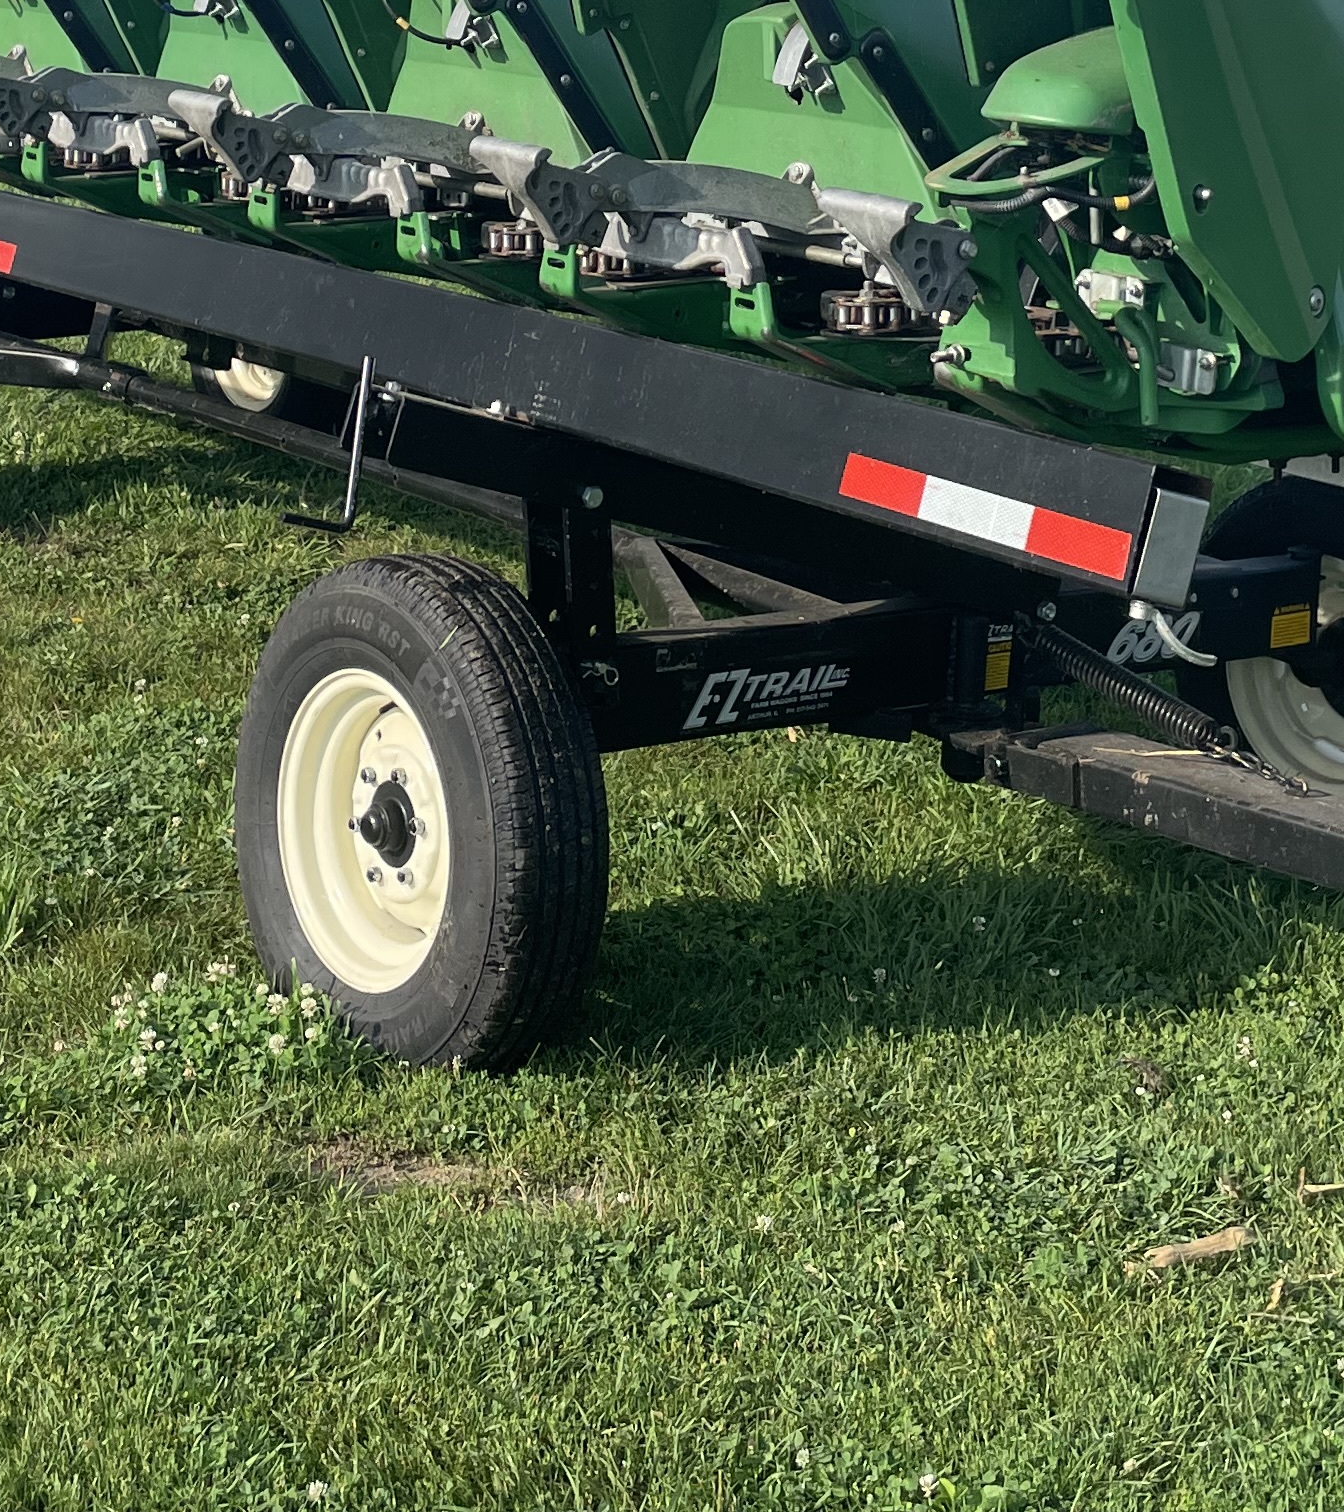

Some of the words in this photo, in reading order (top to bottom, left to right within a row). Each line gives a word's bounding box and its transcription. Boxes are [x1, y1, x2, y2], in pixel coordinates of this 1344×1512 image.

[333, 605, 374, 631] KING
[377, 620, 411, 656] RST
[1106, 610, 1201, 665] 680
[743, 663, 847, 701] TRAIL
